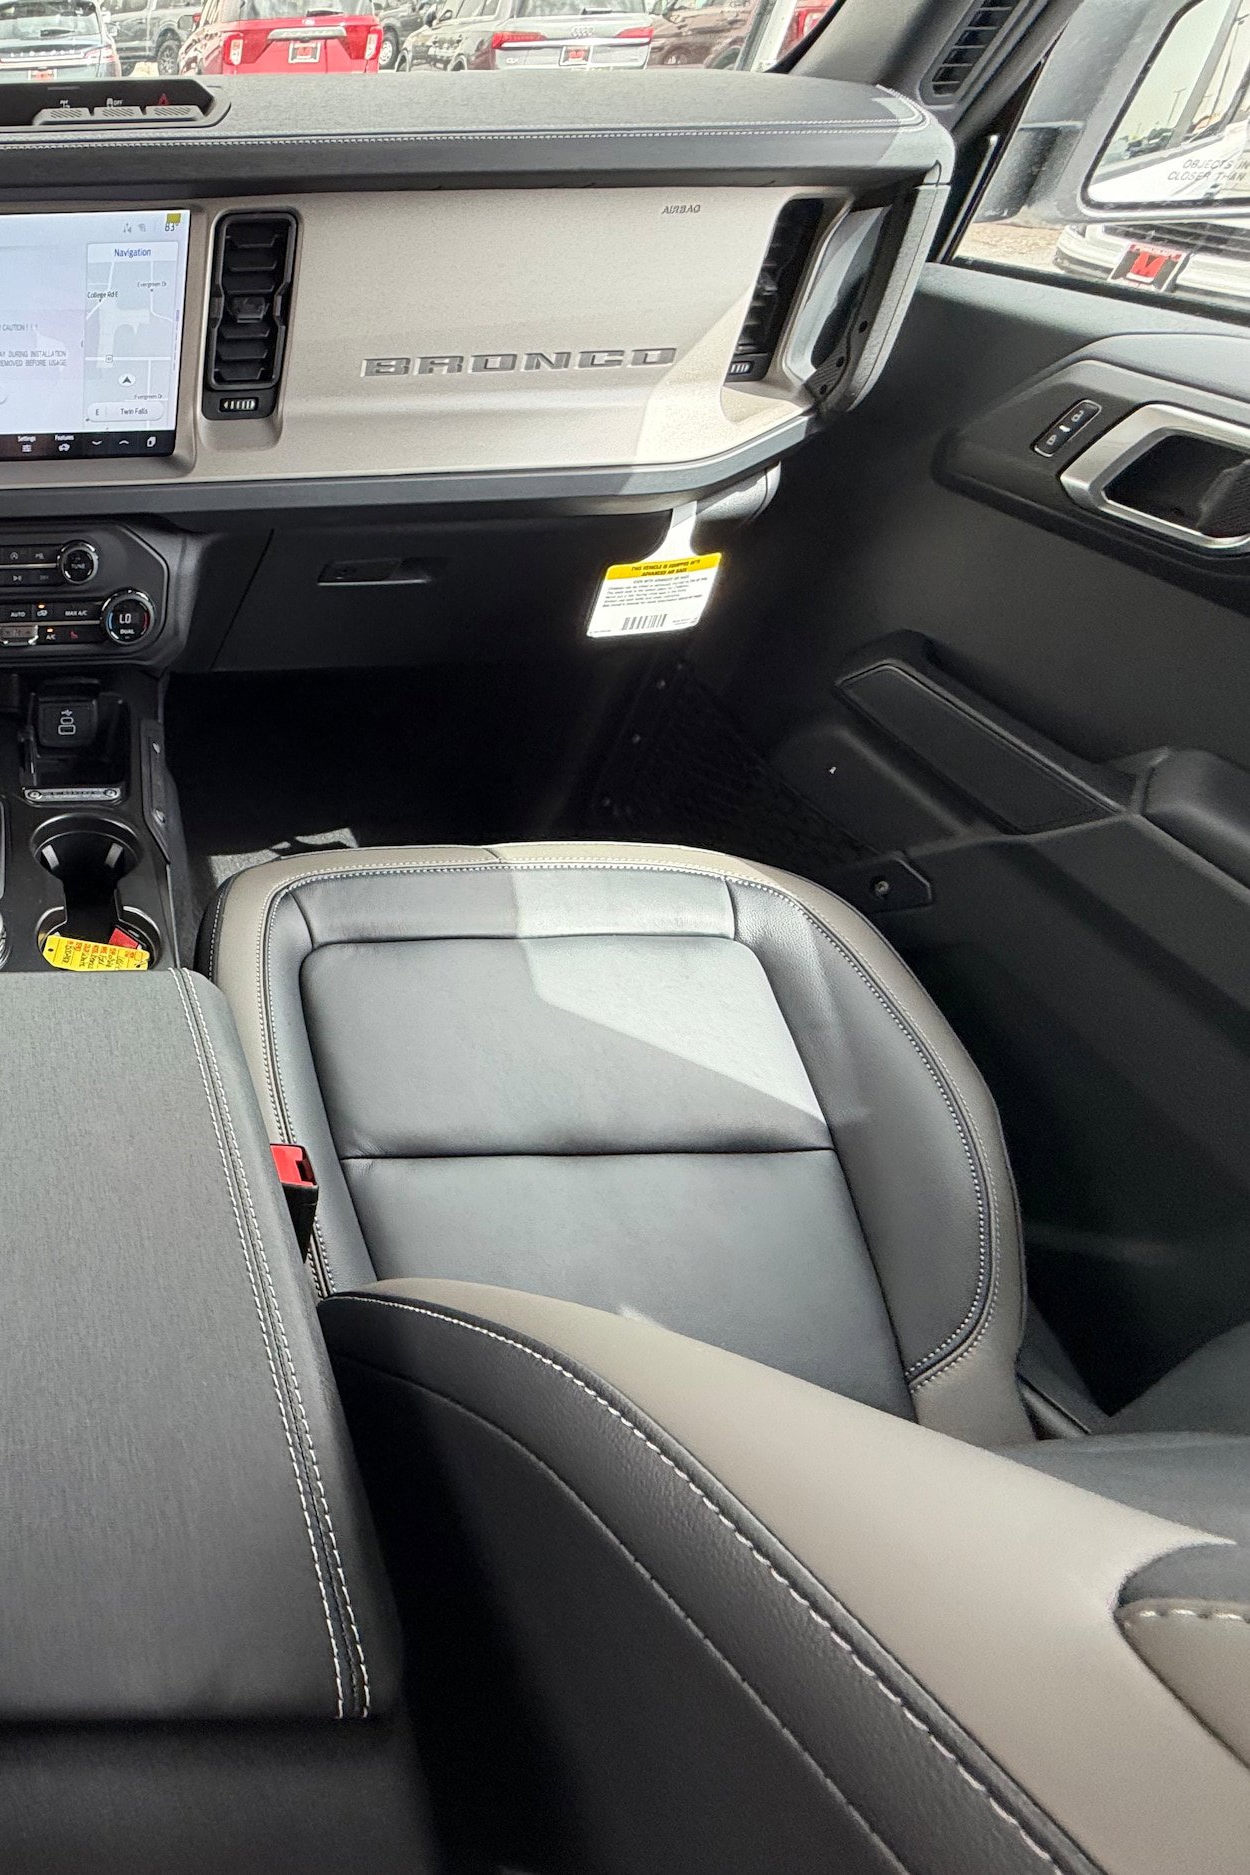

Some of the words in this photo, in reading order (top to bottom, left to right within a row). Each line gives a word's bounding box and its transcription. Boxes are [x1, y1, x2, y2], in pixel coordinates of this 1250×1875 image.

[1182, 158, 1233, 169] OBJECTS
[1167, 171, 1211, 181] CLOSER
[1215, 171, 1247, 181] THAN
[661, 204, 701, 215] AIRBAG
[114, 248, 151, 258] Navigation
[87, 291, 106, 299] College
[361, 347, 677, 378] BRONCO
[17, 435, 37, 443] Settings
